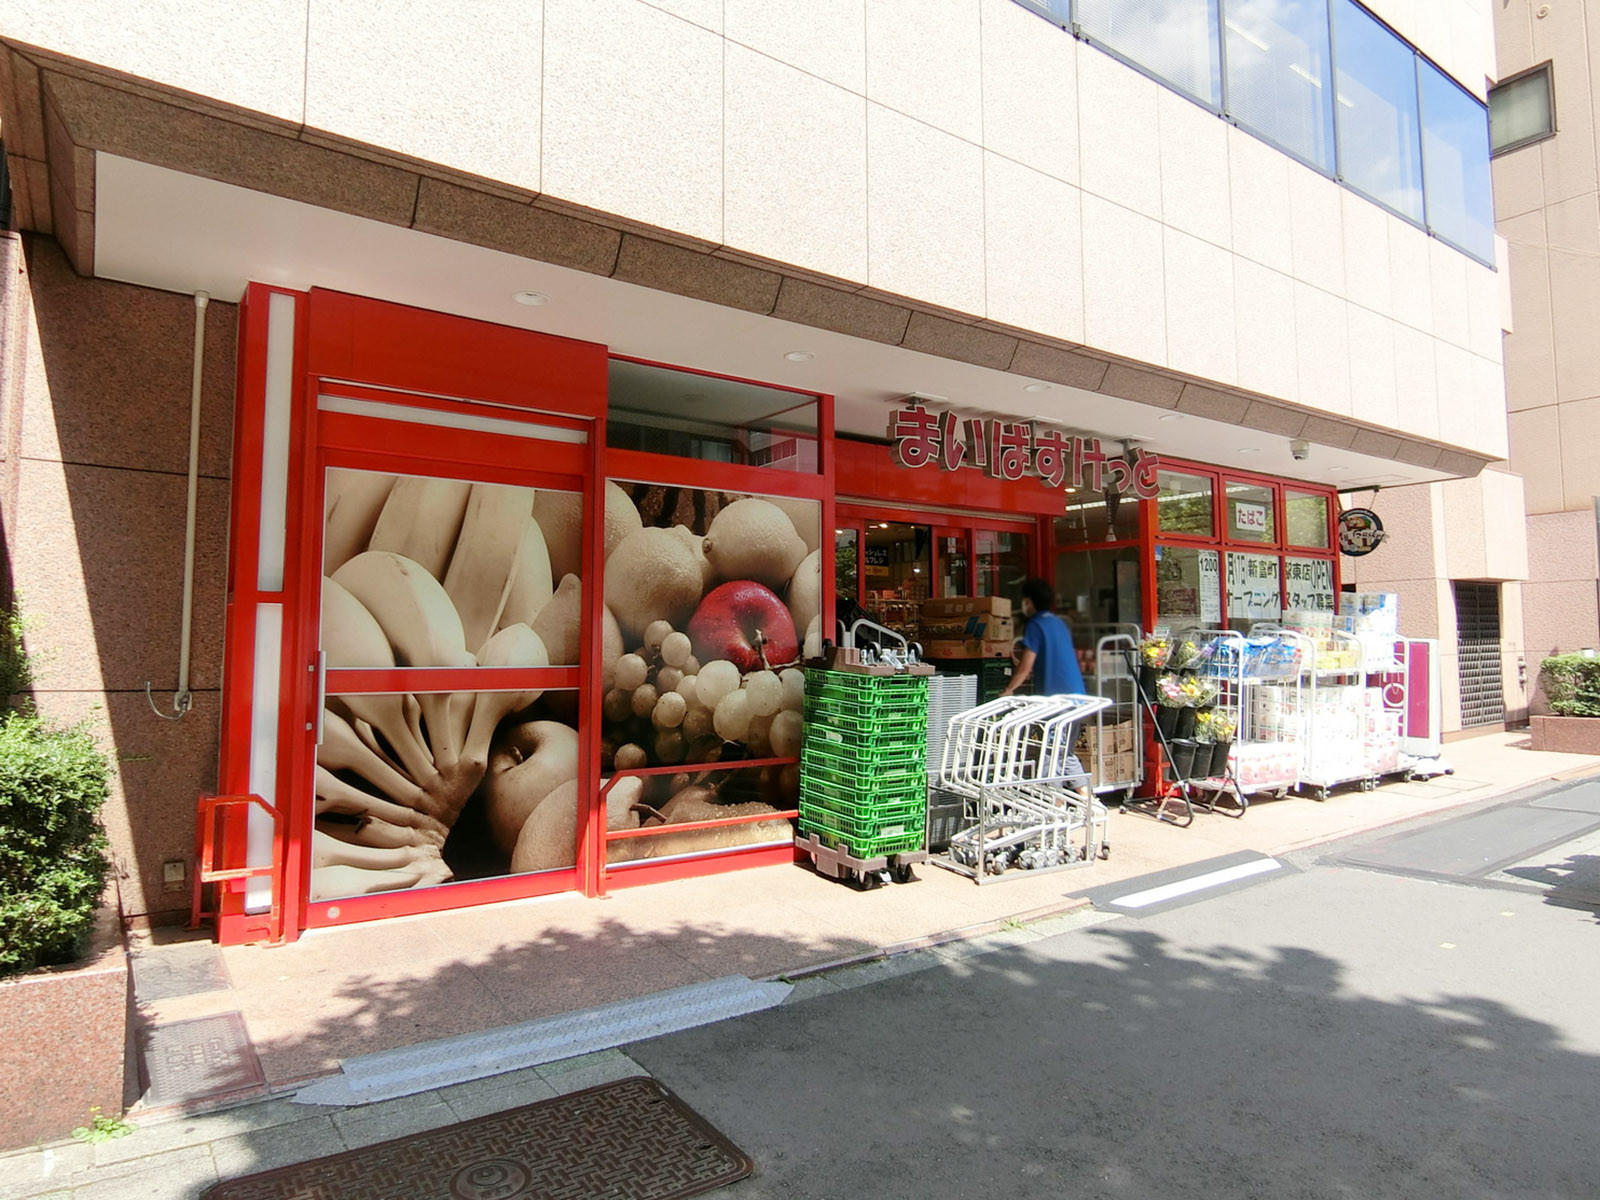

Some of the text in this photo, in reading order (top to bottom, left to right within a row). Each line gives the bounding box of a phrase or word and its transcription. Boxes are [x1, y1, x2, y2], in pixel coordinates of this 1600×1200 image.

[891, 404, 1160, 499] まいばすけっと
